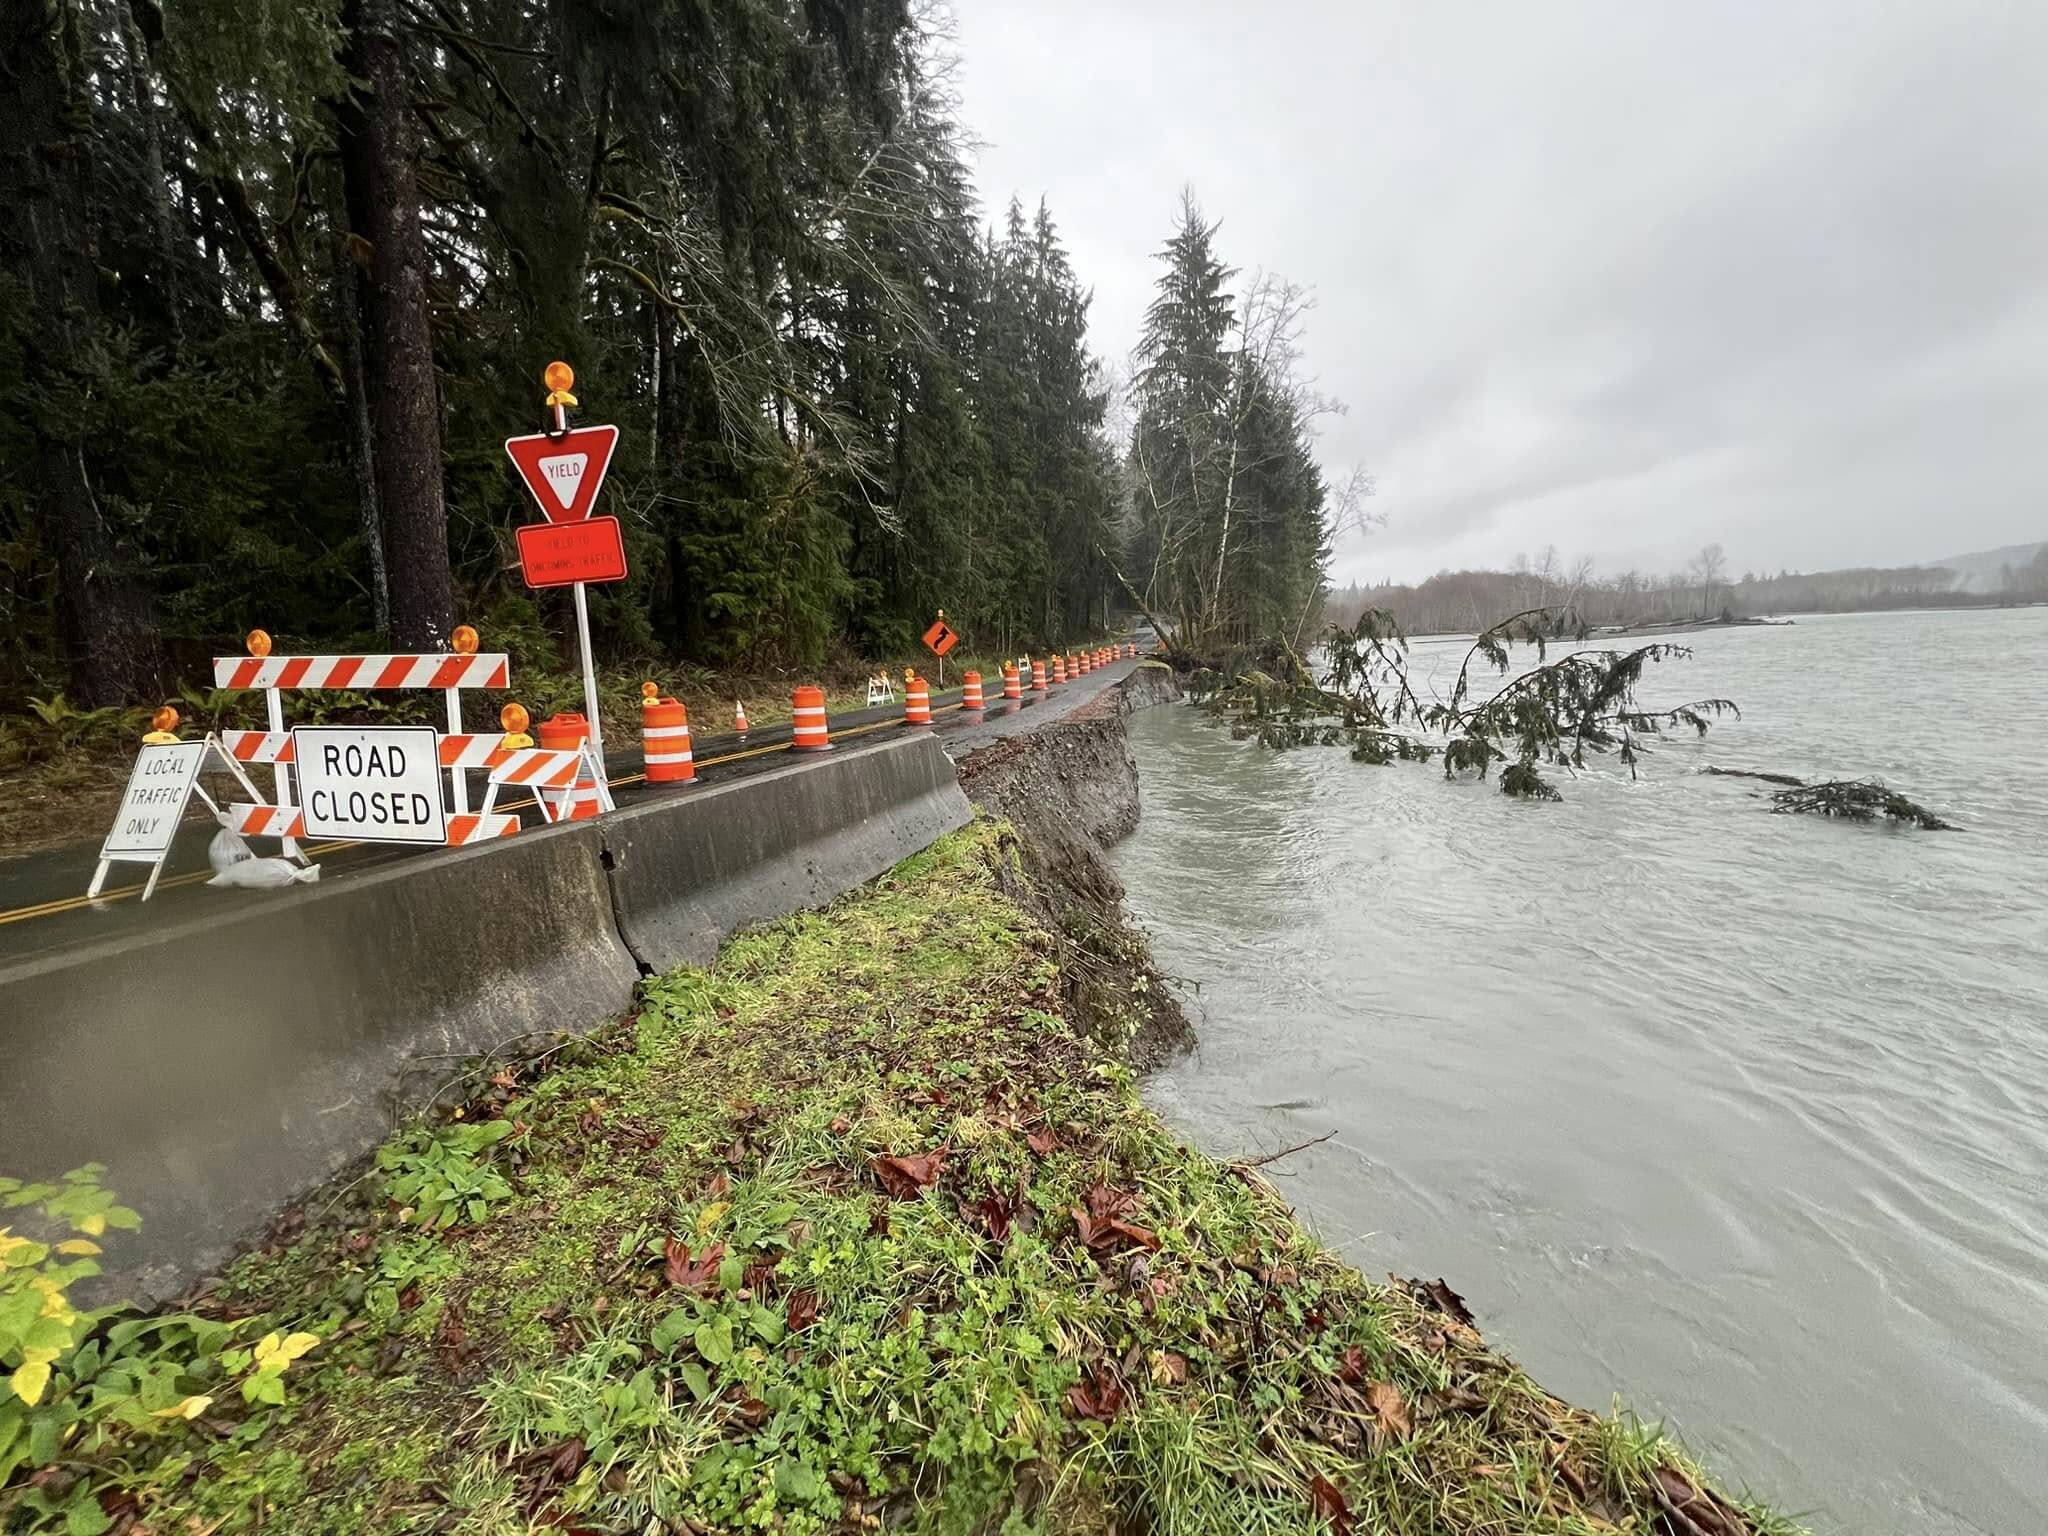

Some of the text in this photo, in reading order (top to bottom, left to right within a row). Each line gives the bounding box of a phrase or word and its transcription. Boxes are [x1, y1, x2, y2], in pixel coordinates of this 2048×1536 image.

[548, 462, 581, 479] YIELD
[145, 758, 185, 776] LOCAL
[324, 744, 406, 778] ROAD
[131, 787, 182, 805] TRAFFIC
[312, 790, 430, 825] CLOSED
[126, 817, 160, 835] ONLY
